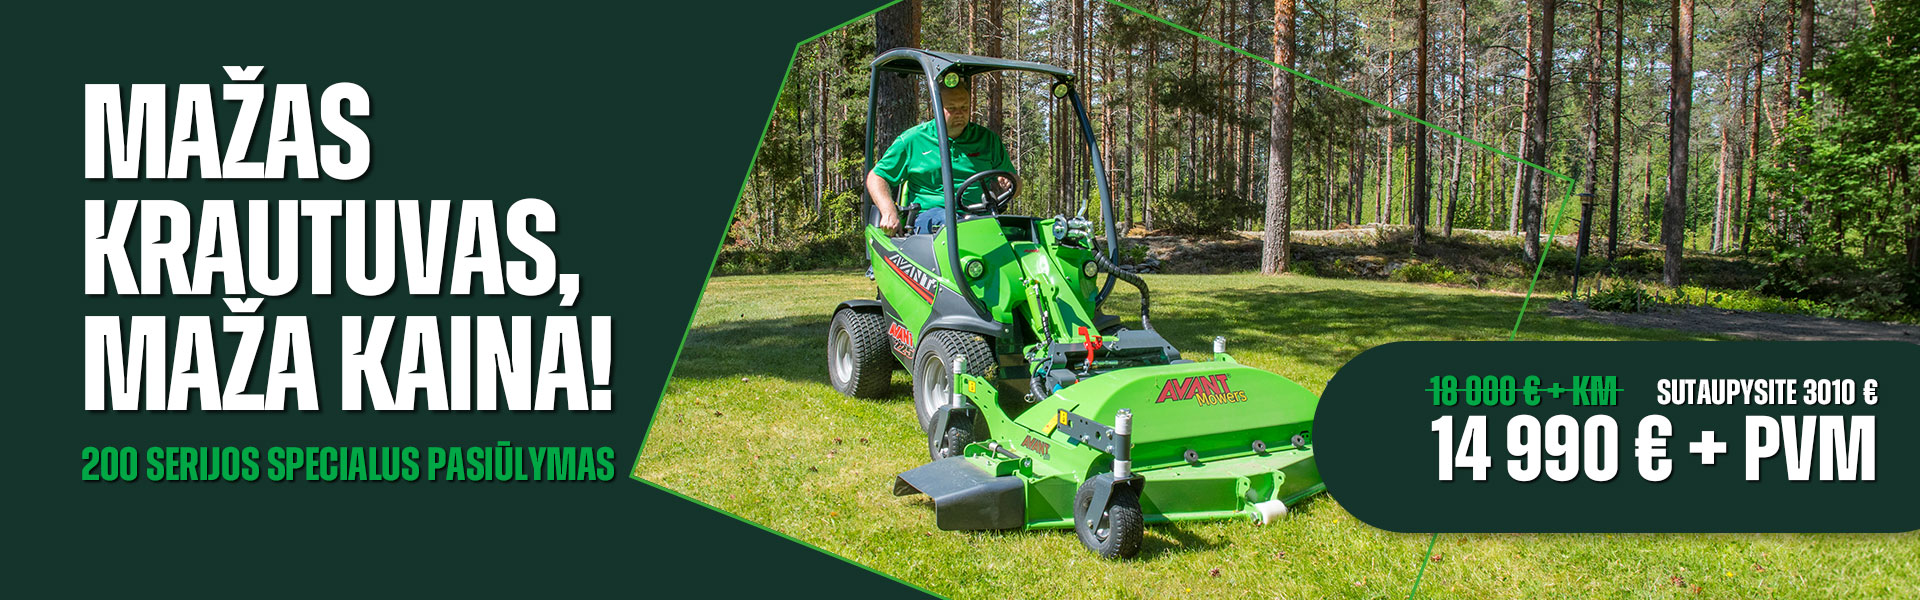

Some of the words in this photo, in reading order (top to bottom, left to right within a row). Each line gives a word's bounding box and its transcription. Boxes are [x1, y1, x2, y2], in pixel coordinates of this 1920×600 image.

[889, 254, 938, 290] AVANT
[1155, 373, 1230, 404] AVANT
[1195, 389, 1248, 407] Mowers
